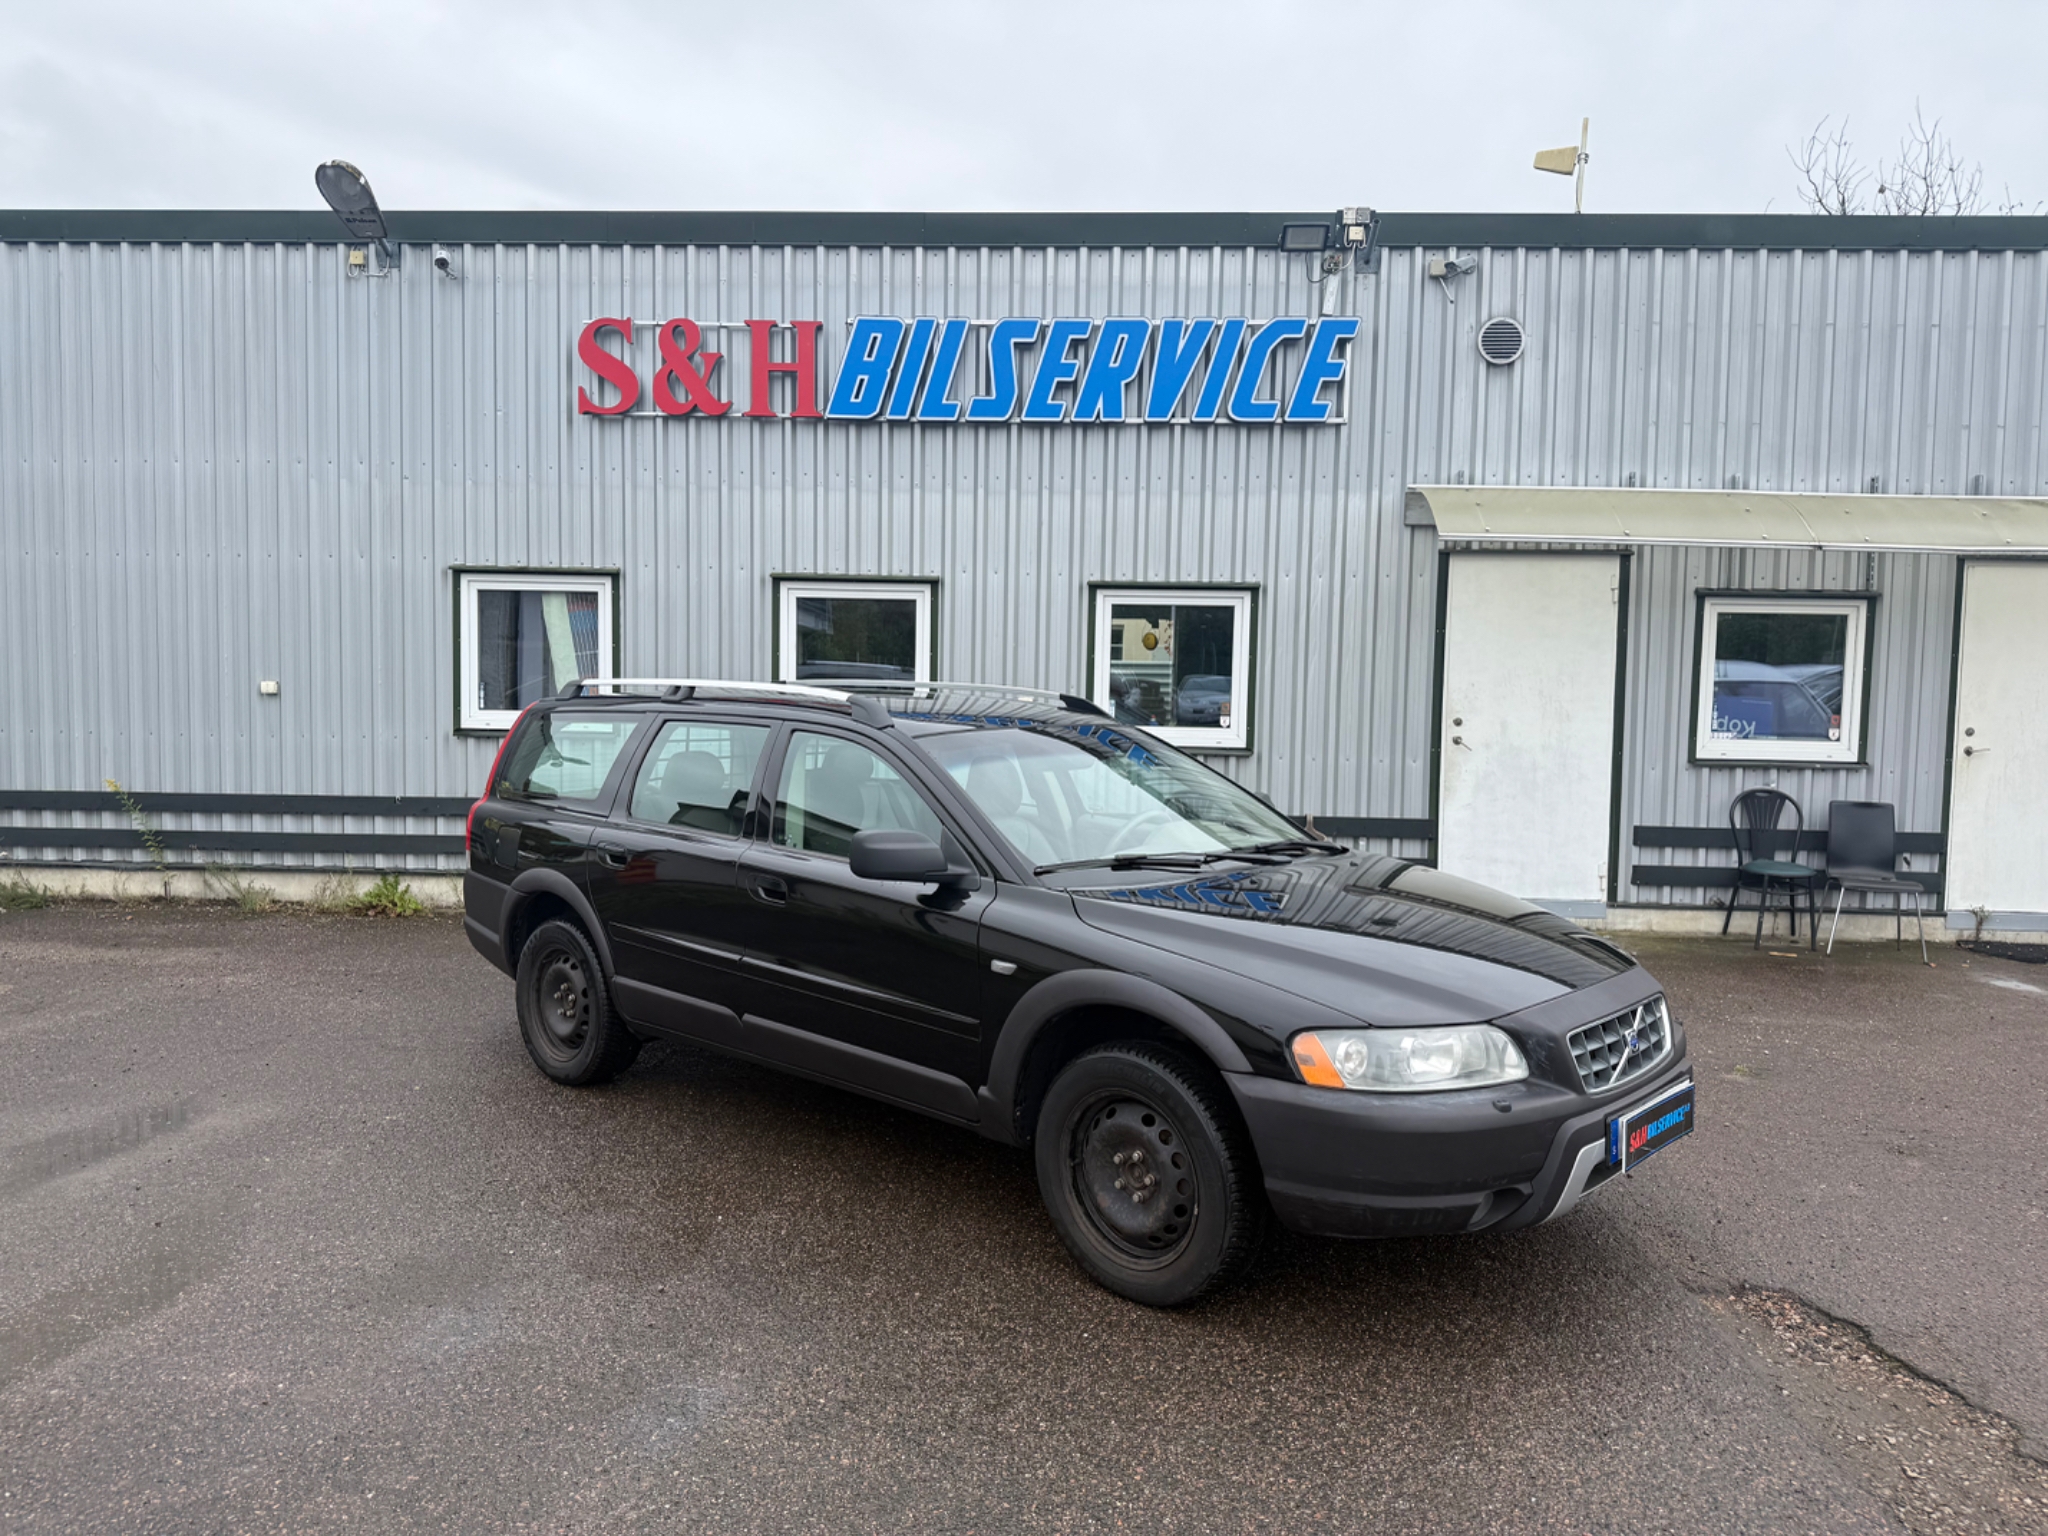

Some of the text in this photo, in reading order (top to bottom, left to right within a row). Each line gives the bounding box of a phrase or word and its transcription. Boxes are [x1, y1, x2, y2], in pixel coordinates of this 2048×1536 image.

[577, 315, 1361, 422] S&H BILSERVICE
[1647, 1106, 1685, 1140] BILSERVICE
